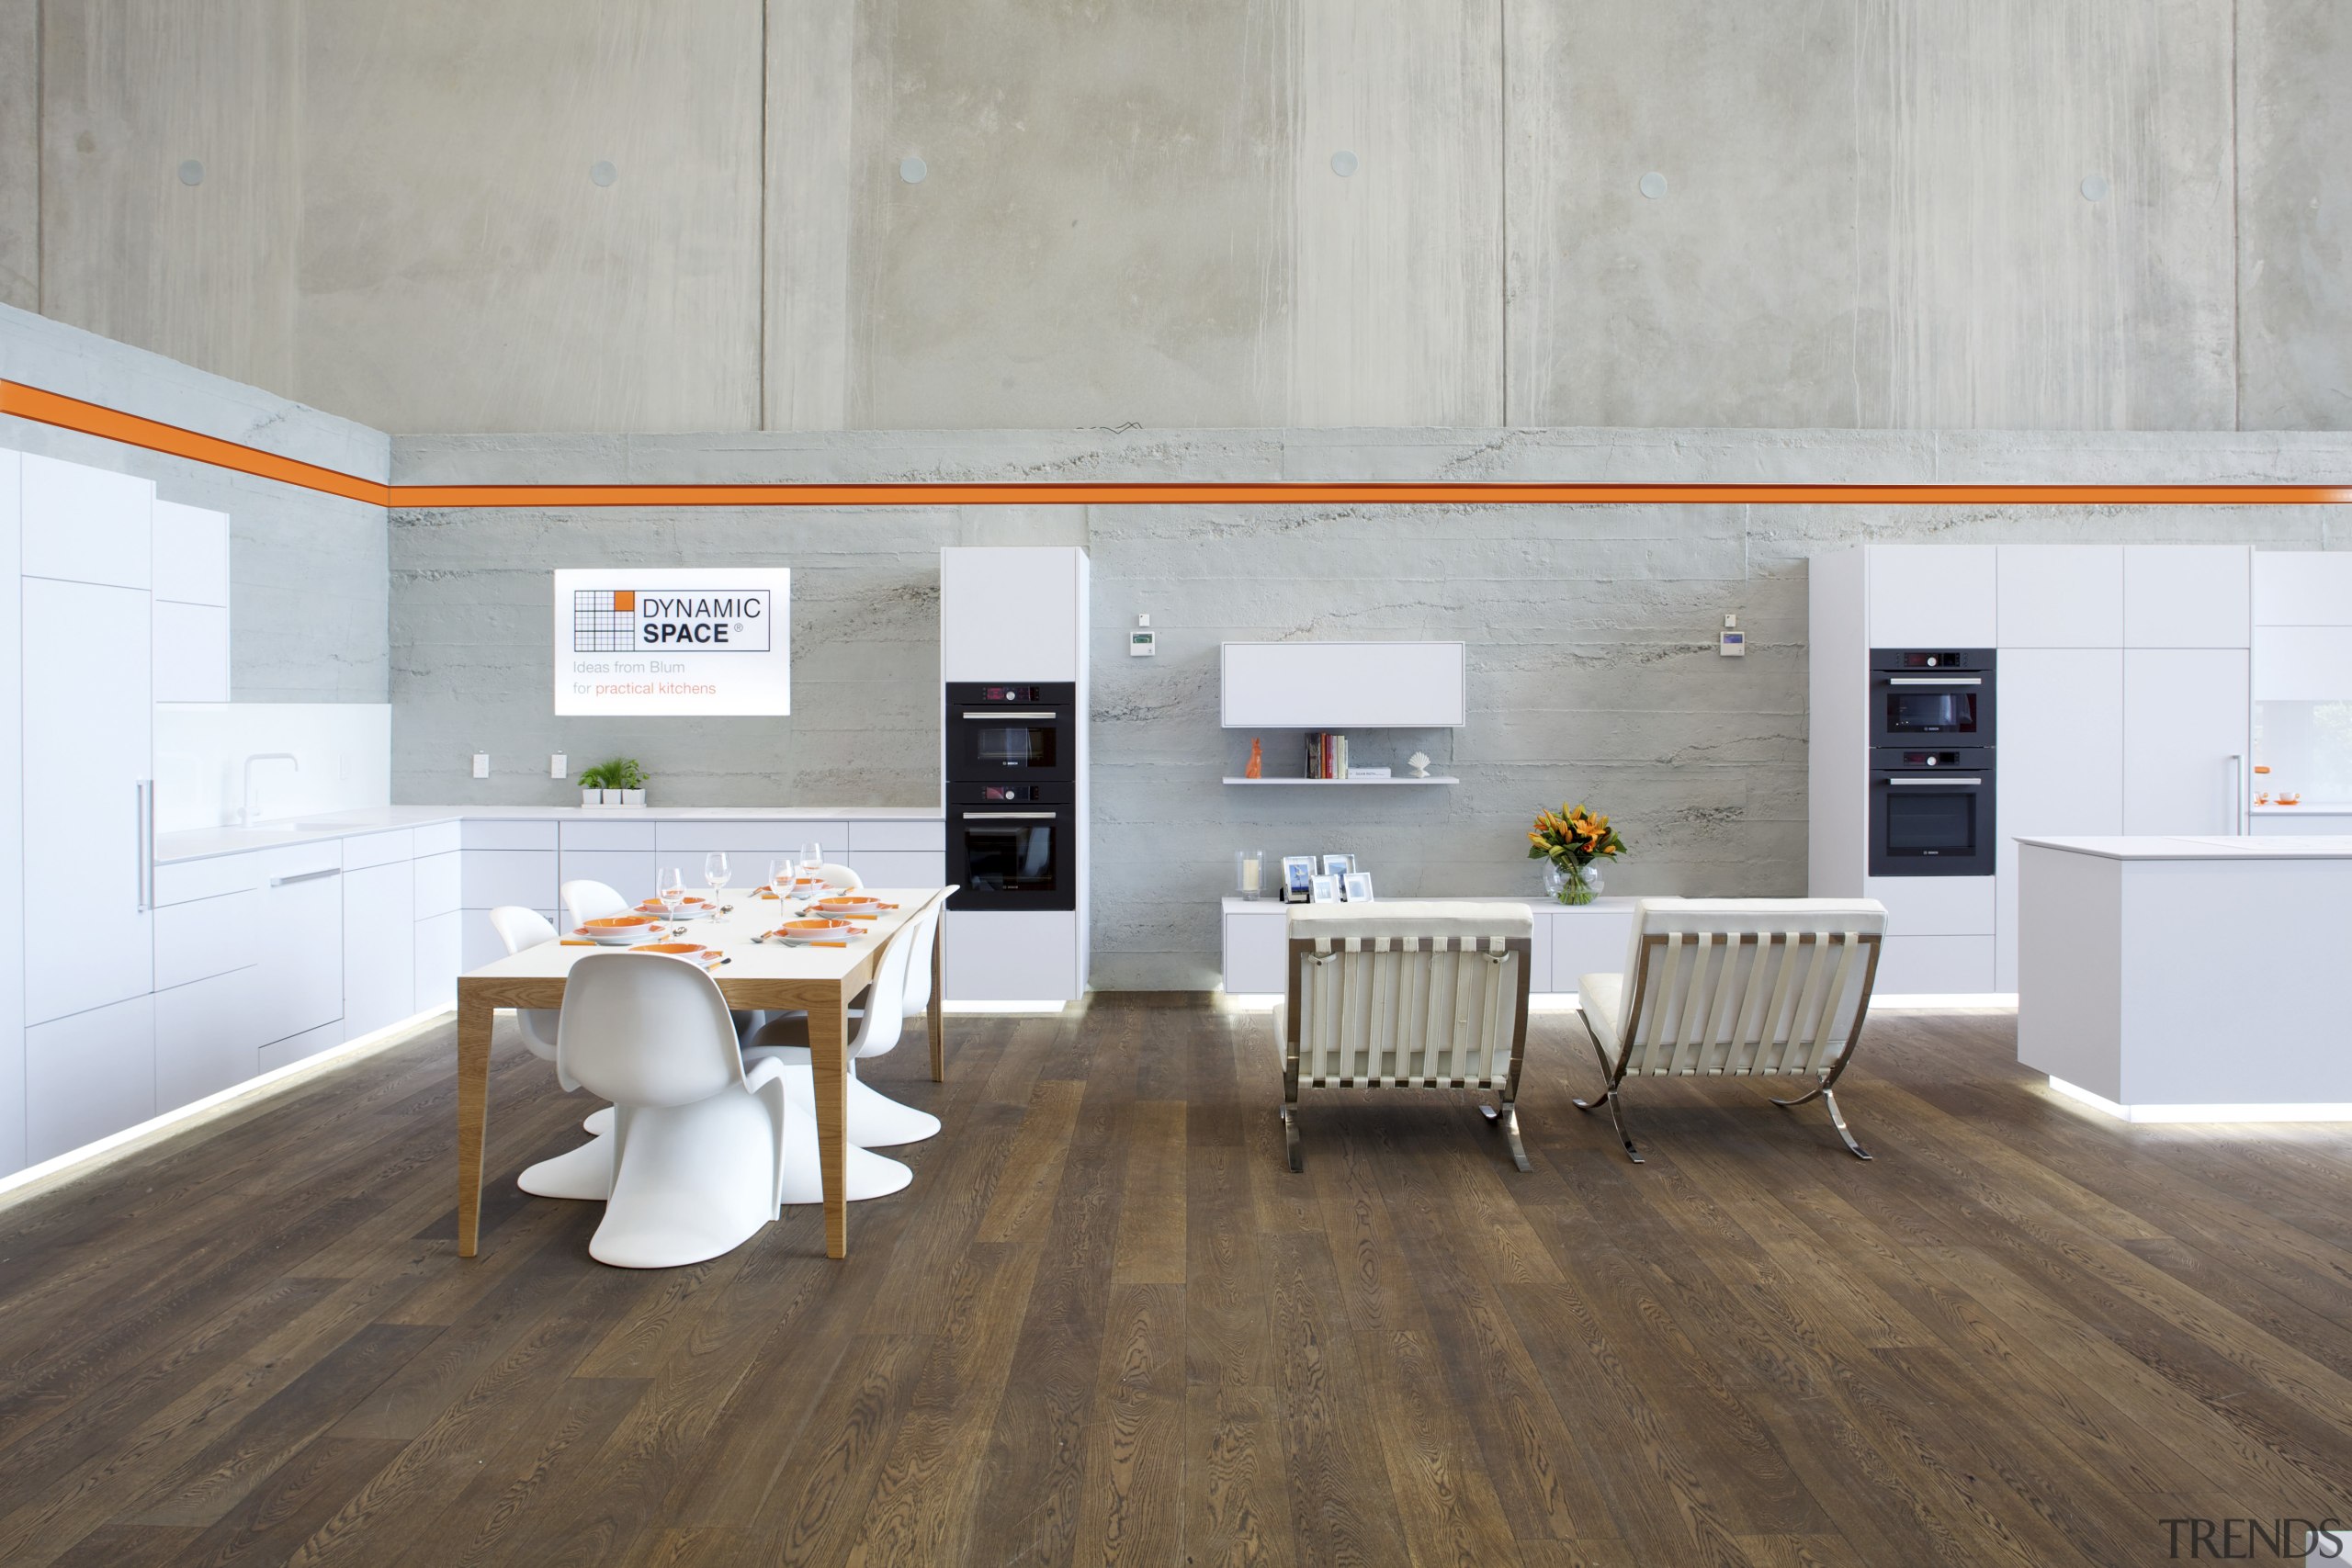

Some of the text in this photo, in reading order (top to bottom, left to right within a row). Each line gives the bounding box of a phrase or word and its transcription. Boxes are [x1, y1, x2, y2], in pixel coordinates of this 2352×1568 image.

[643, 598, 761, 618] DYNAMIC
[573, 660, 685, 673] Ideas from Blum
[573, 682, 717, 696] for practical kitchens
